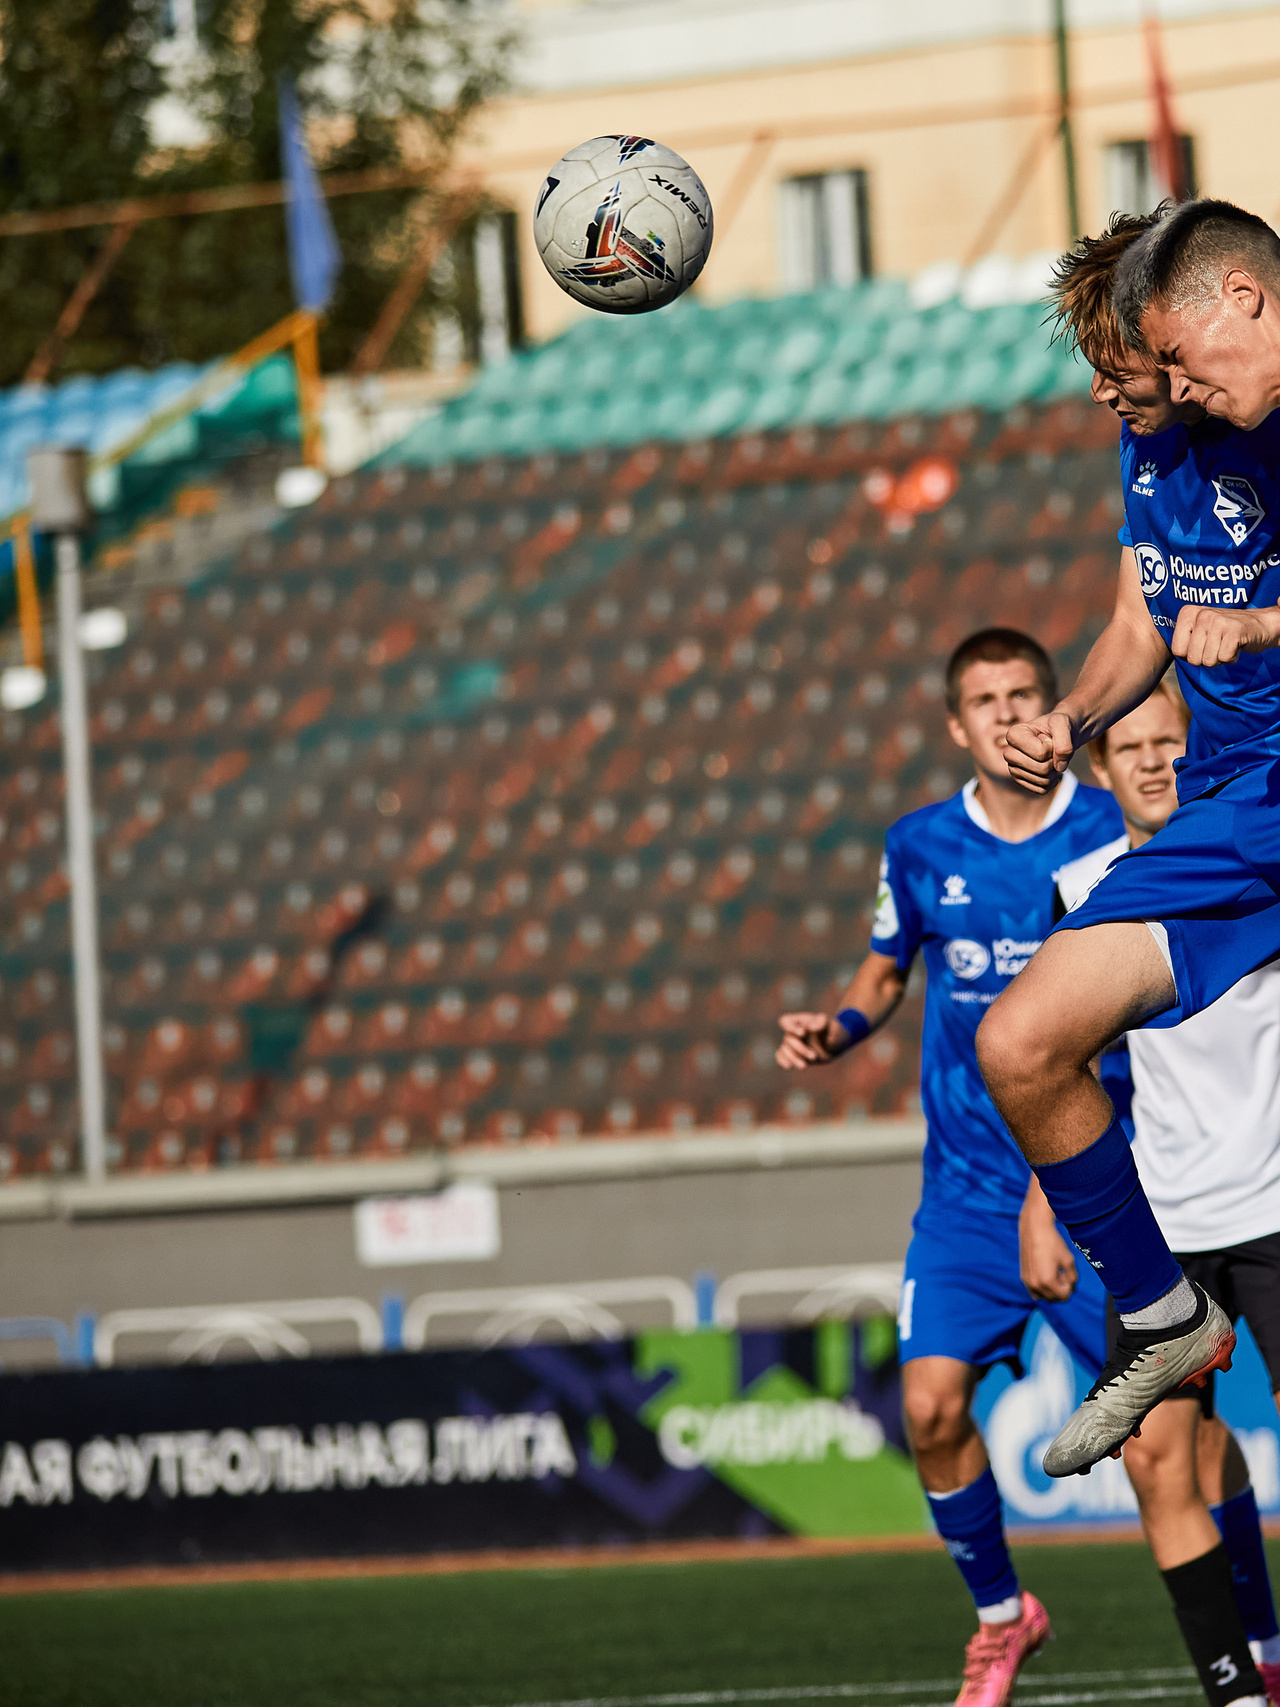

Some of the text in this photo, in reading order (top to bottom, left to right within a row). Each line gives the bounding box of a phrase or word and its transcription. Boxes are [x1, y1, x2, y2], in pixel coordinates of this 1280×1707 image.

[648, 173, 708, 230] DEMIX
[1131, 483, 1155, 497] KELME
[1169, 553, 1280, 585] Юнисервис
[1172, 578, 1249, 605] Капитал
[657, 1396, 885, 1470] СИБИРЬ
[76, 1417, 429, 1503] ФУТБОЛЬНАЯ
[431, 1410, 578, 1486] ЛИГА
[1210, 1654, 1238, 1686] 3
